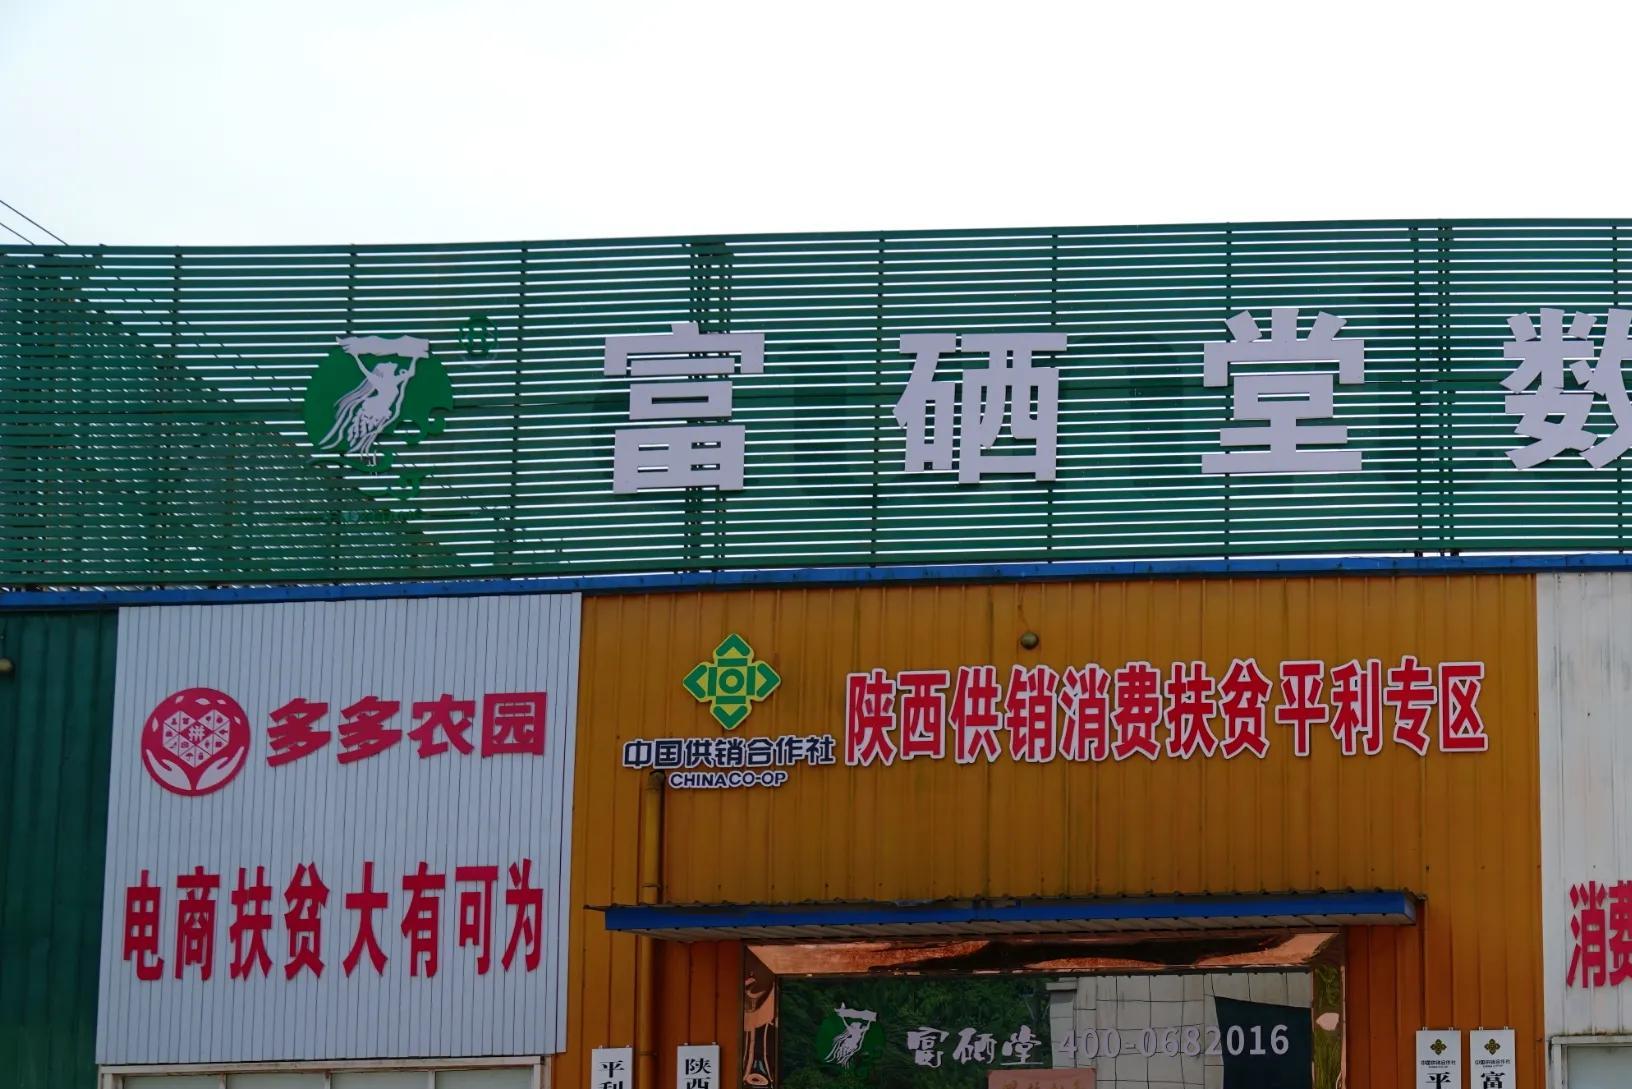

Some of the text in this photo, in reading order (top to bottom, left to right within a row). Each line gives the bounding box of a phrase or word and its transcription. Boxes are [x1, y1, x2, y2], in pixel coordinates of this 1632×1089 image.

[266, 691, 548, 768] 多多农园
[844, 655, 1490, 768] 陕西供销消费扶贫平利专区
[622, 734, 837, 769] 中国供销合作社
[123, 858, 544, 982] 电商扶贫大有可为
[906, 1025, 1044, 1069] 富硒堂
[1056, 1023, 1290, 1060] 400-0682016
